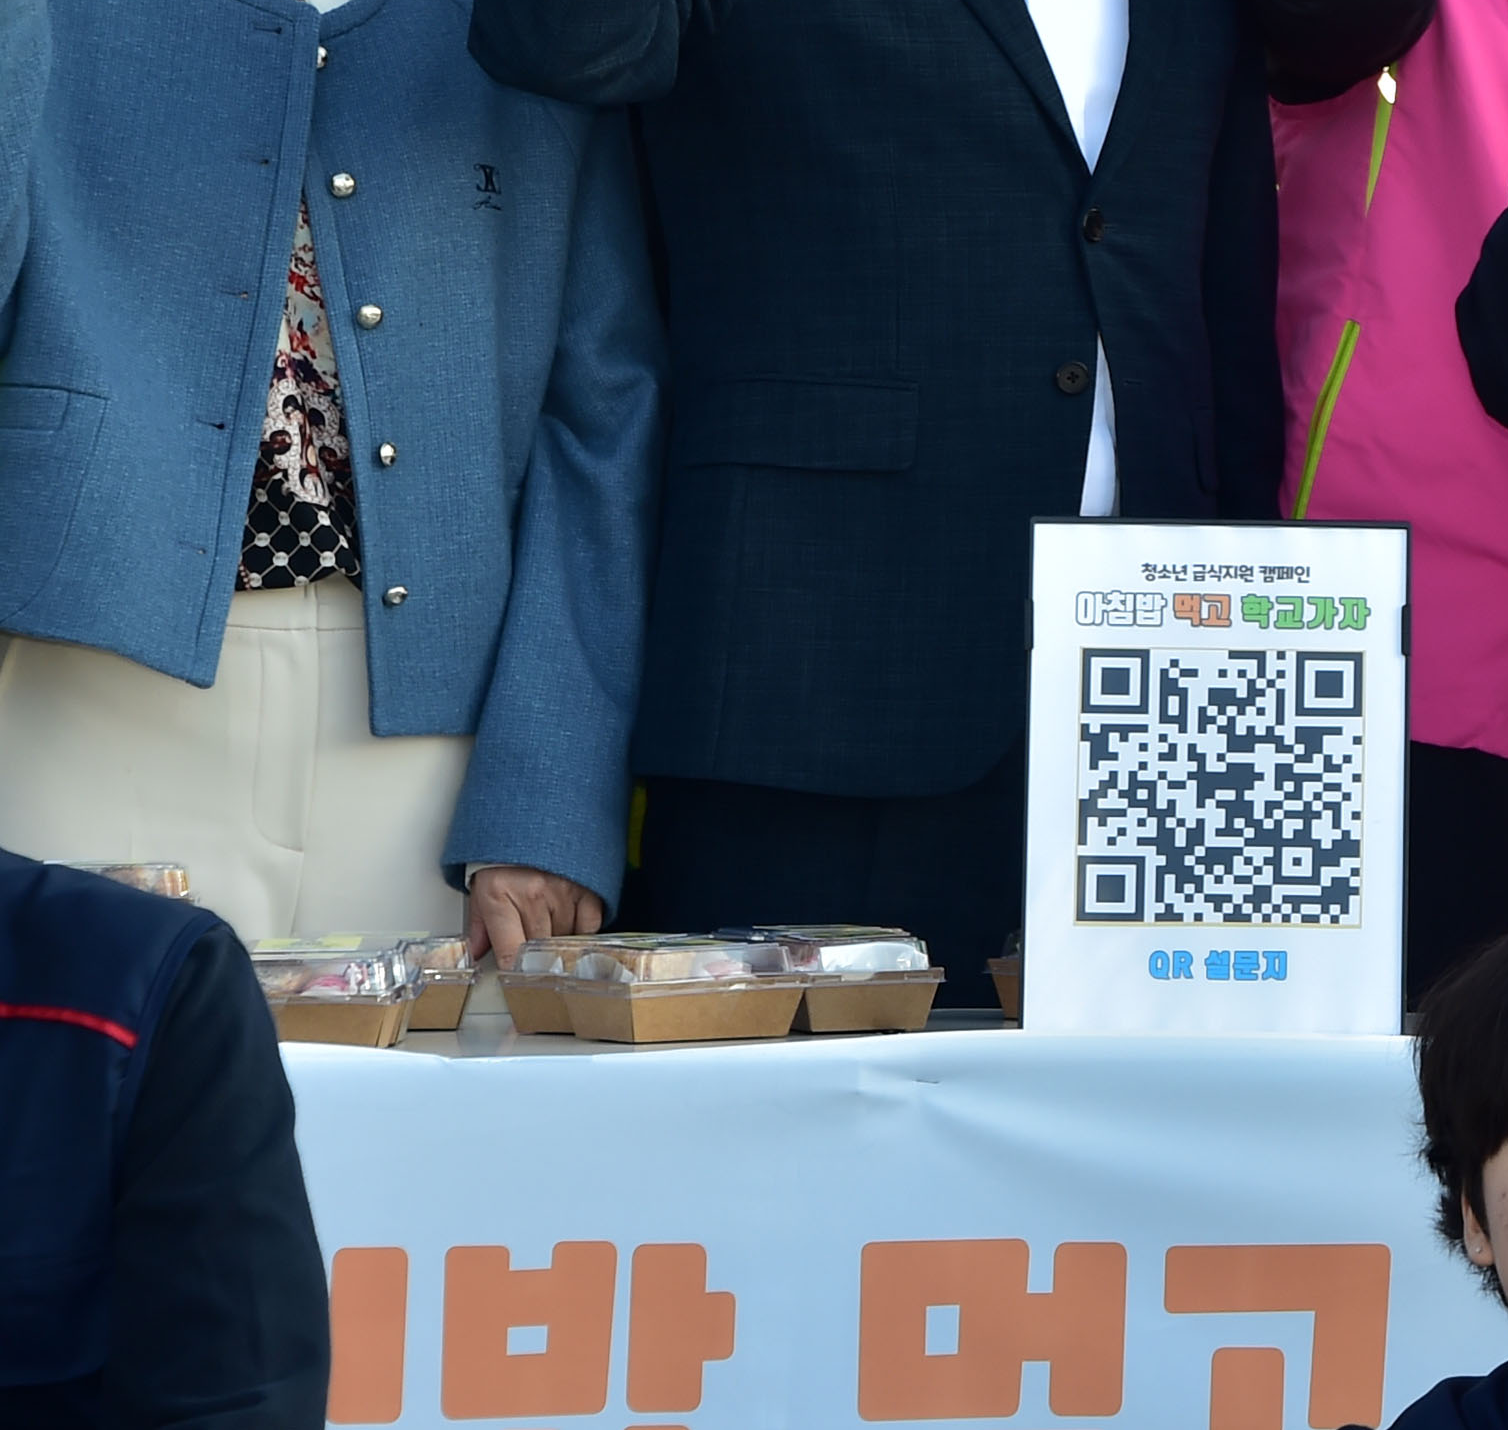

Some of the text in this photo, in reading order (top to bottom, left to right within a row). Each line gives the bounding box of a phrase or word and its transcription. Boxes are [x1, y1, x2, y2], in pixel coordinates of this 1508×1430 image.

[1141, 562, 1310, 584] 청소년 급식지원 캠페인
[1075, 590, 1372, 631] 아침밥 먹고 학교가자
[1148, 949, 1288, 981] QR 설문지
